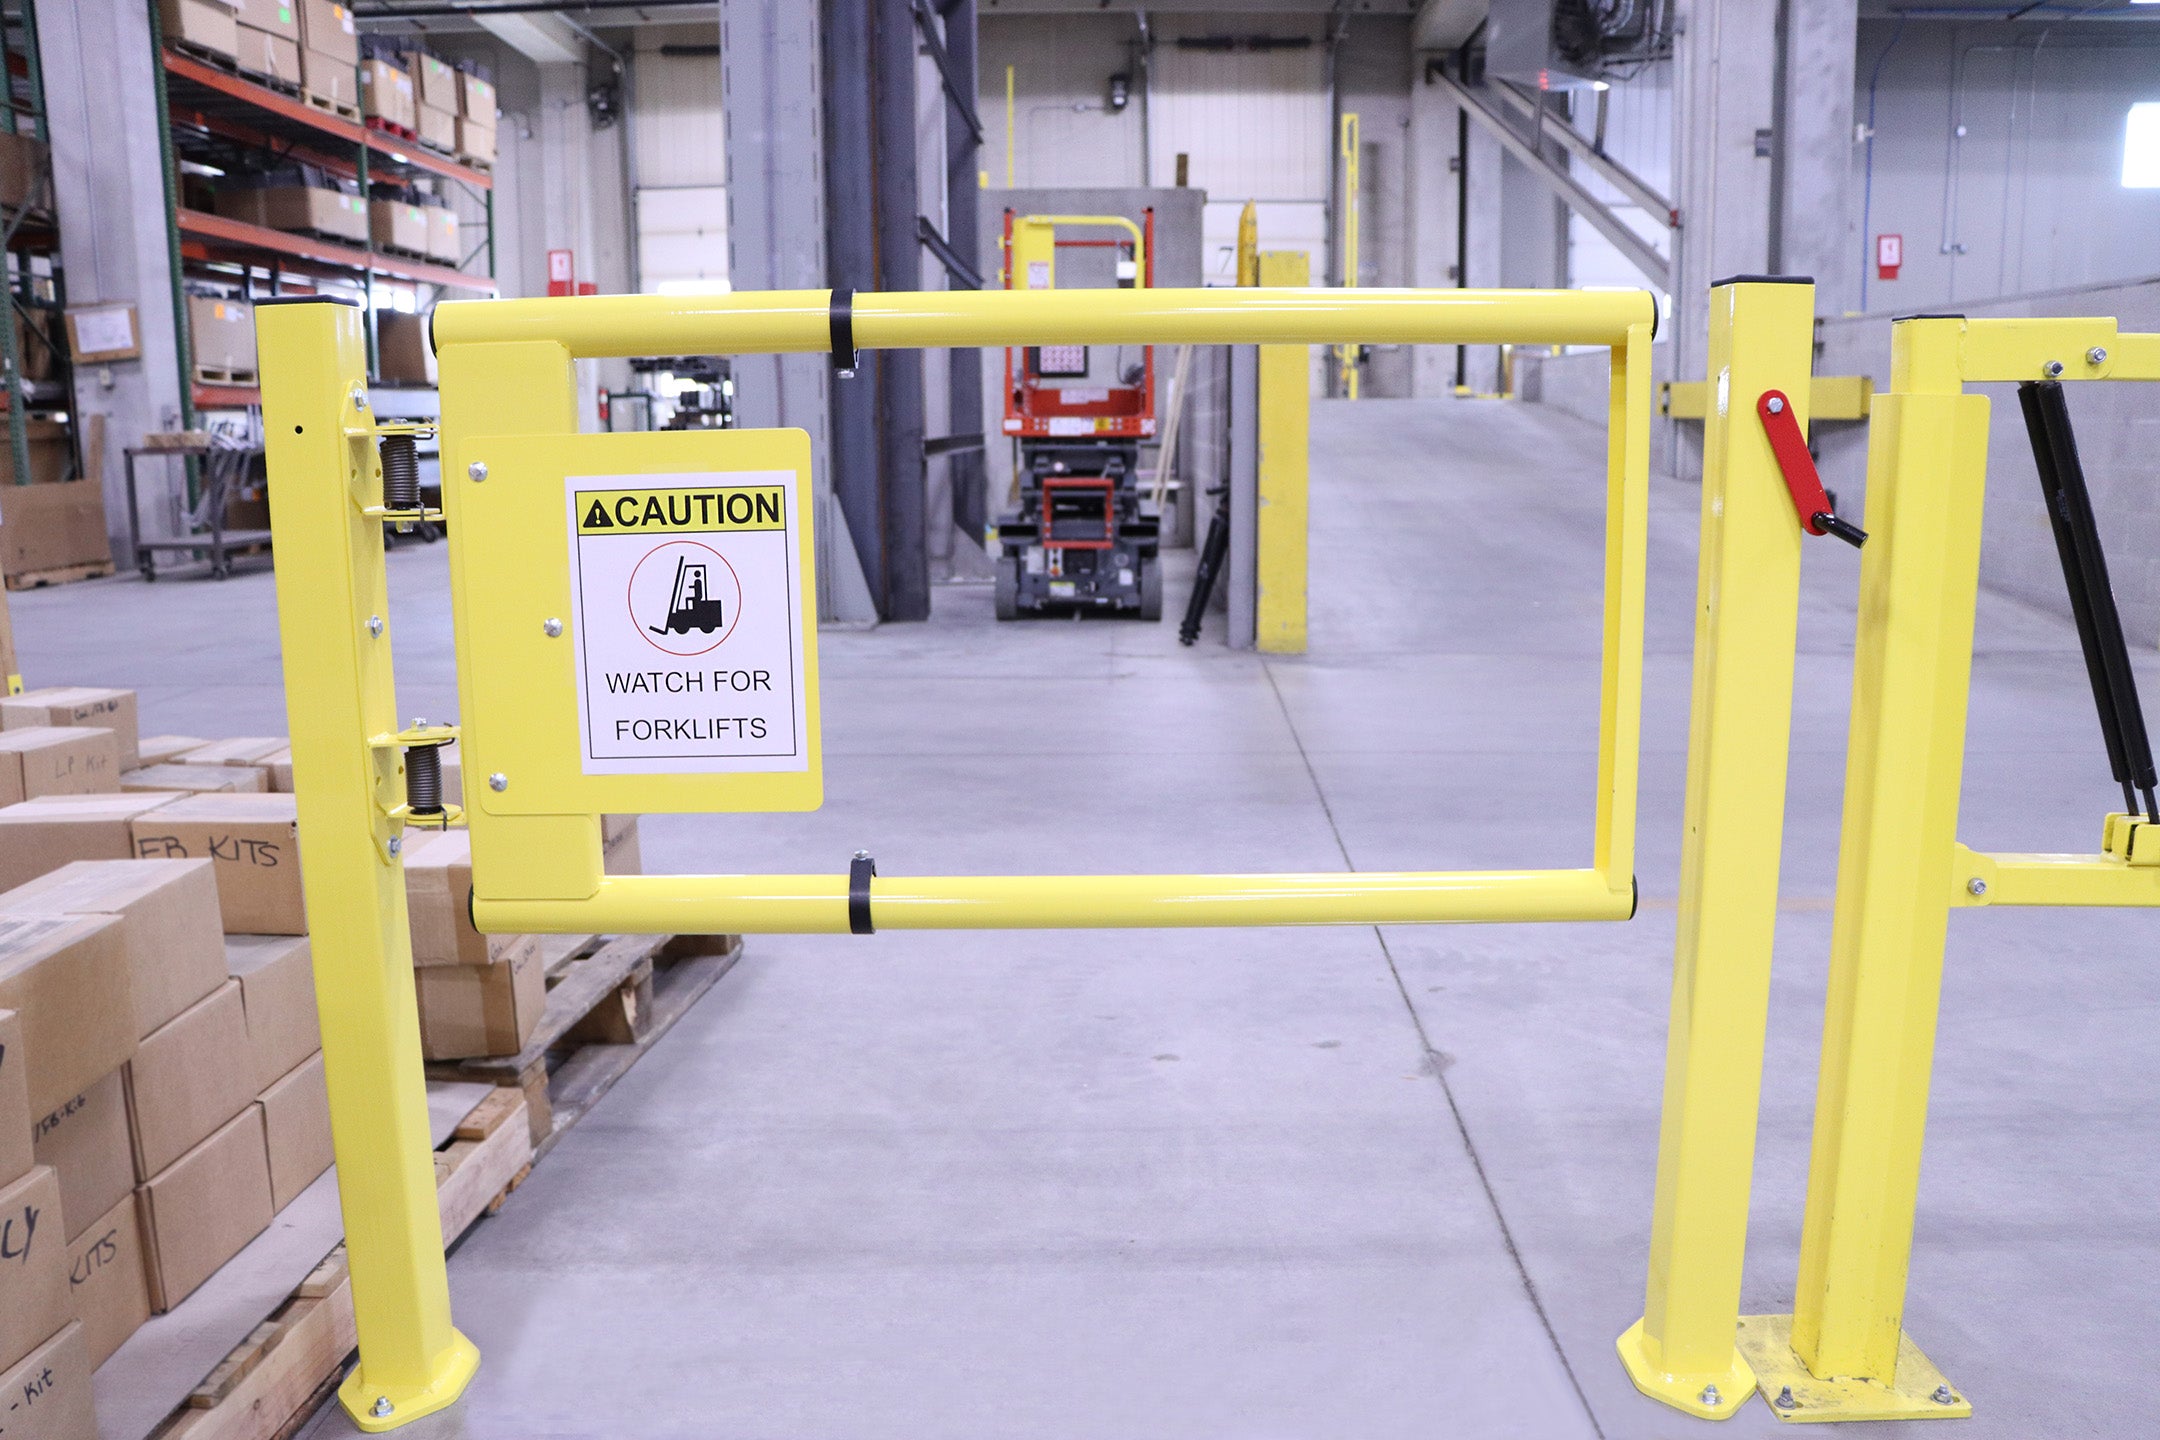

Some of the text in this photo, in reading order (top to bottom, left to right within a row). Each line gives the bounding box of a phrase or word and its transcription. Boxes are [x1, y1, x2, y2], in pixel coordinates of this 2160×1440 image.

[614, 492, 780, 527] CAUTION
[605, 670, 772, 694] WATCH FOR
[615, 717, 768, 741] FORKLIFTS
[209, 835, 280, 867] KITS
[69, 1228, 117, 1294] KITS
